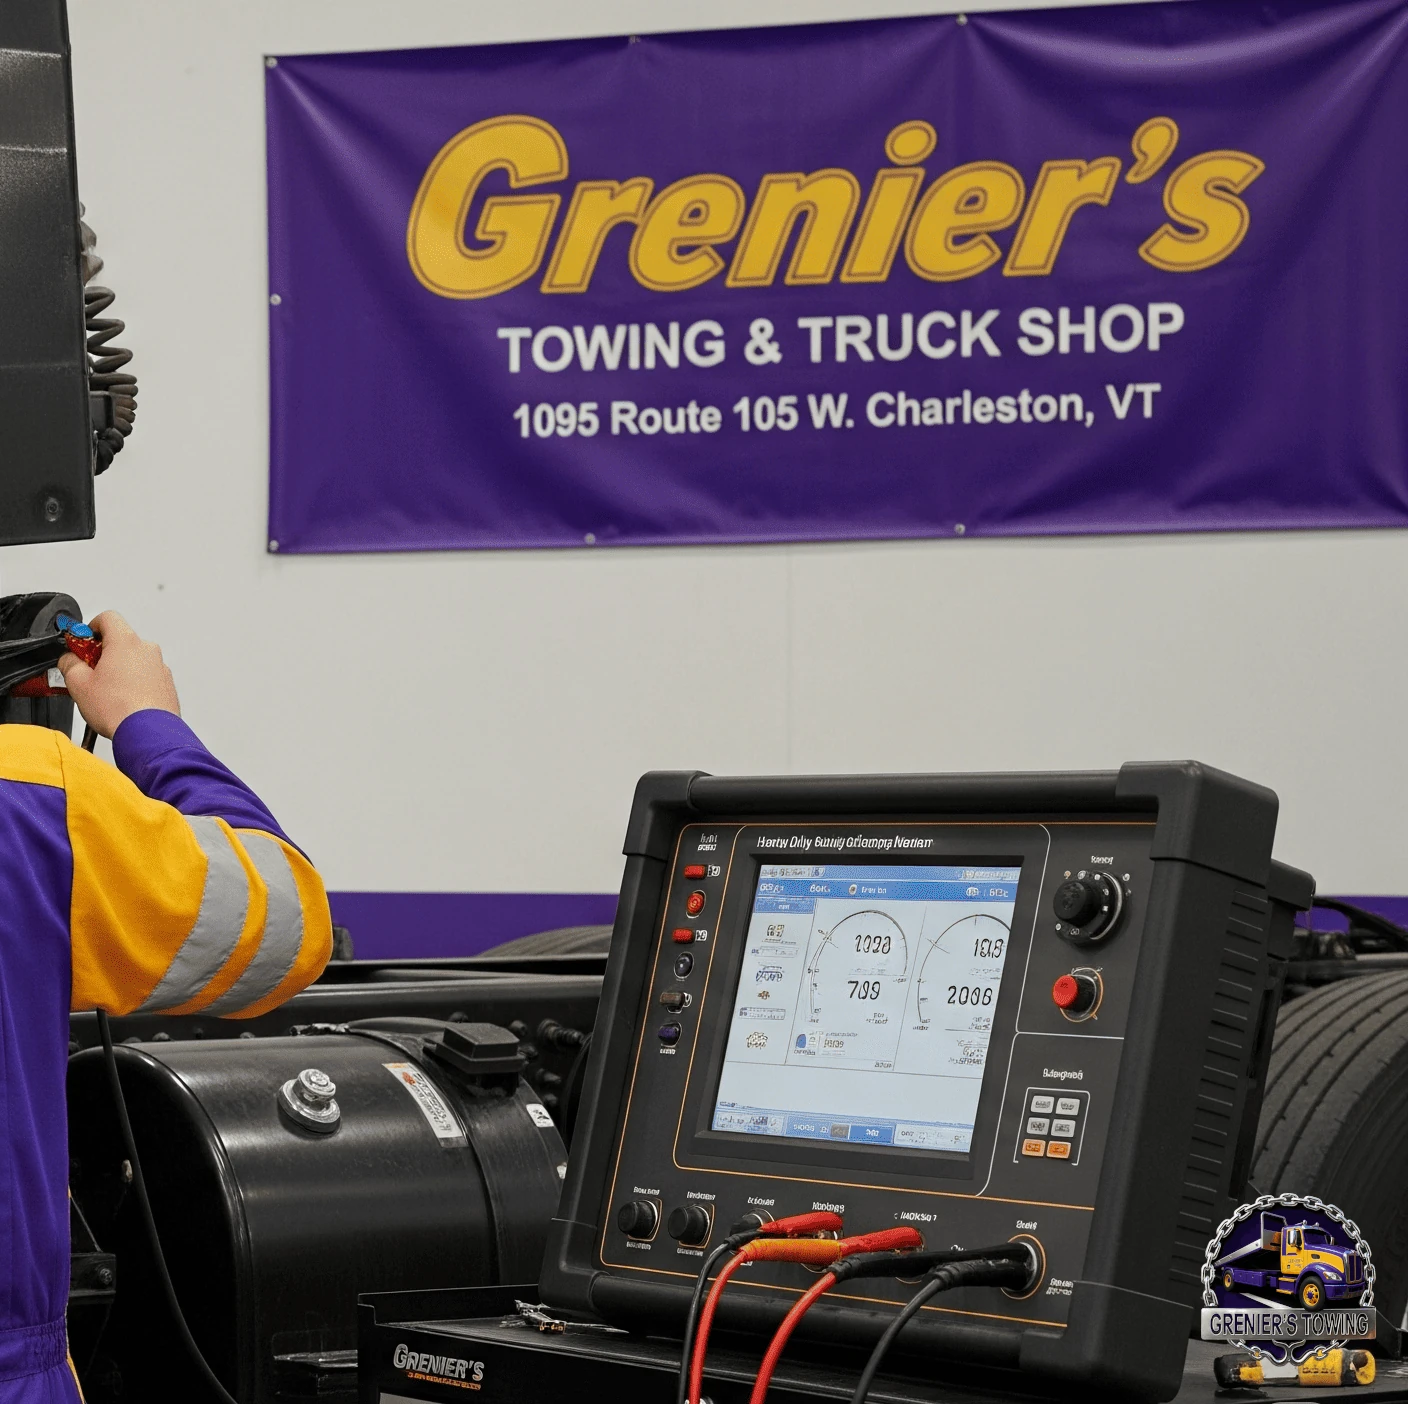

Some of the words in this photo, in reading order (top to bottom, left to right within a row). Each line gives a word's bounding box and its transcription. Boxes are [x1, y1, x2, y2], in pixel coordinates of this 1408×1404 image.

[406, 114, 1266, 301] Grenier's
[497, 320, 725, 373] TOWING
[744, 318, 782, 365] &
[797, 310, 1001, 363] TRUCK
[1017, 303, 1184, 356] SHOP
[514, 402, 599, 438] 1095
[611, 401, 722, 435] Route
[733, 395, 799, 431] 105
[808, 393, 854, 429] W.
[866, 388, 1094, 428] Charleston,
[1106, 383, 1162, 419] VT
[392, 1342, 485, 1383] GRENIER'S
